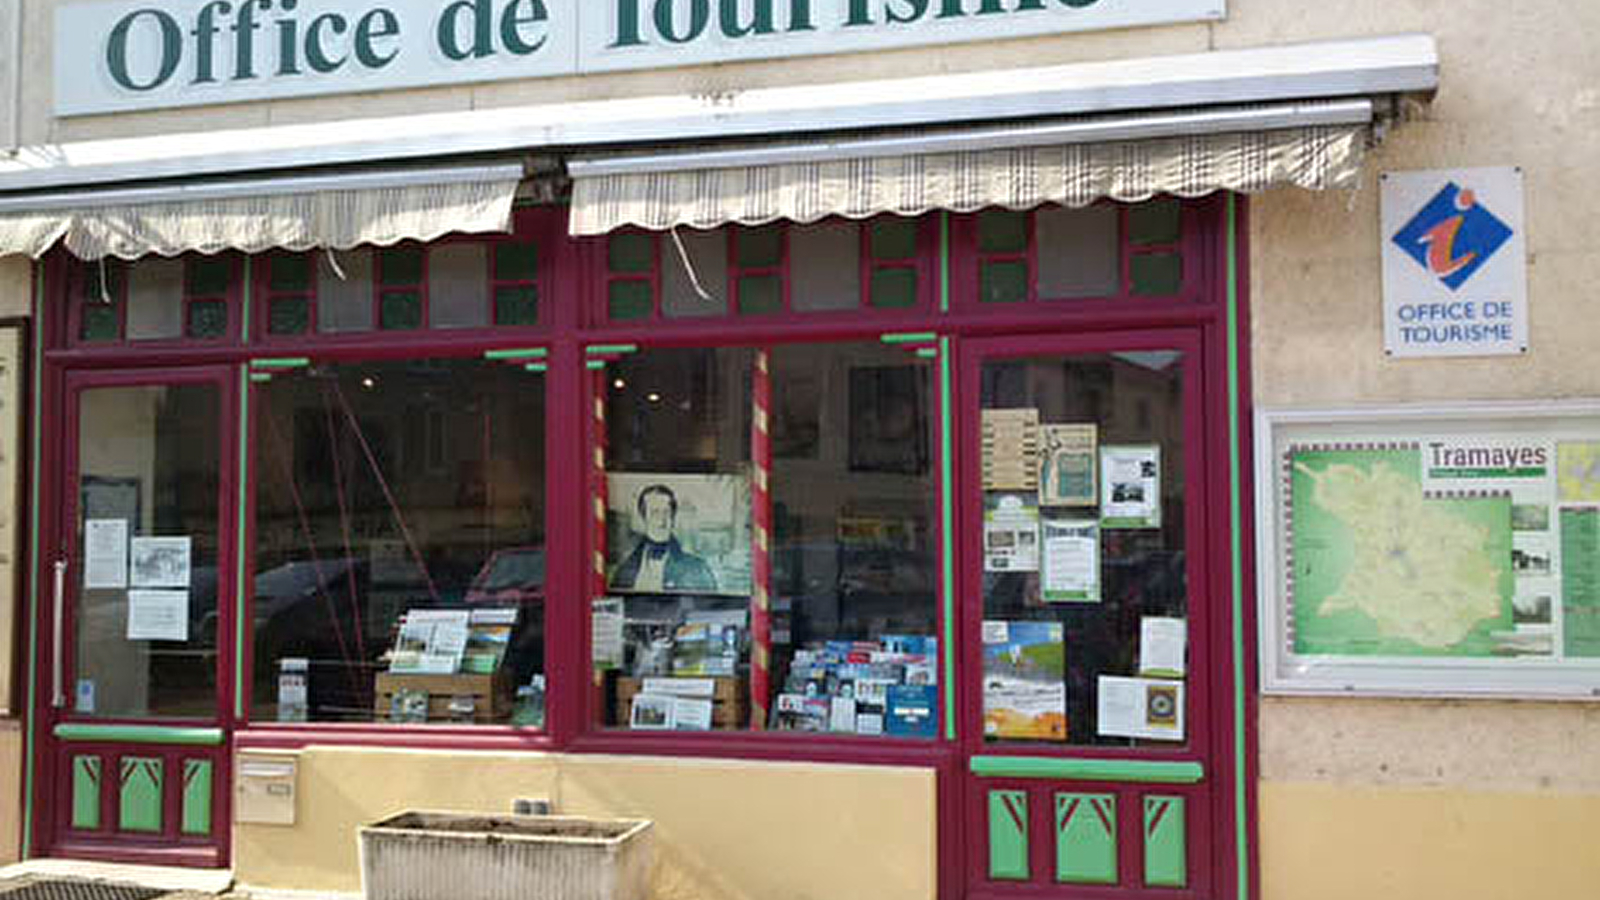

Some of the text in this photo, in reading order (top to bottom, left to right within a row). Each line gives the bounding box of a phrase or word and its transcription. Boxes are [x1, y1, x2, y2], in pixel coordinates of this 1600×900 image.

[106, 0, 1102, 91] Office de Tour
[1398, 301, 1513, 322] OFFICE DE
[1399, 324, 1514, 343] TOURISME
[1429, 442, 1547, 469] Tramayes
